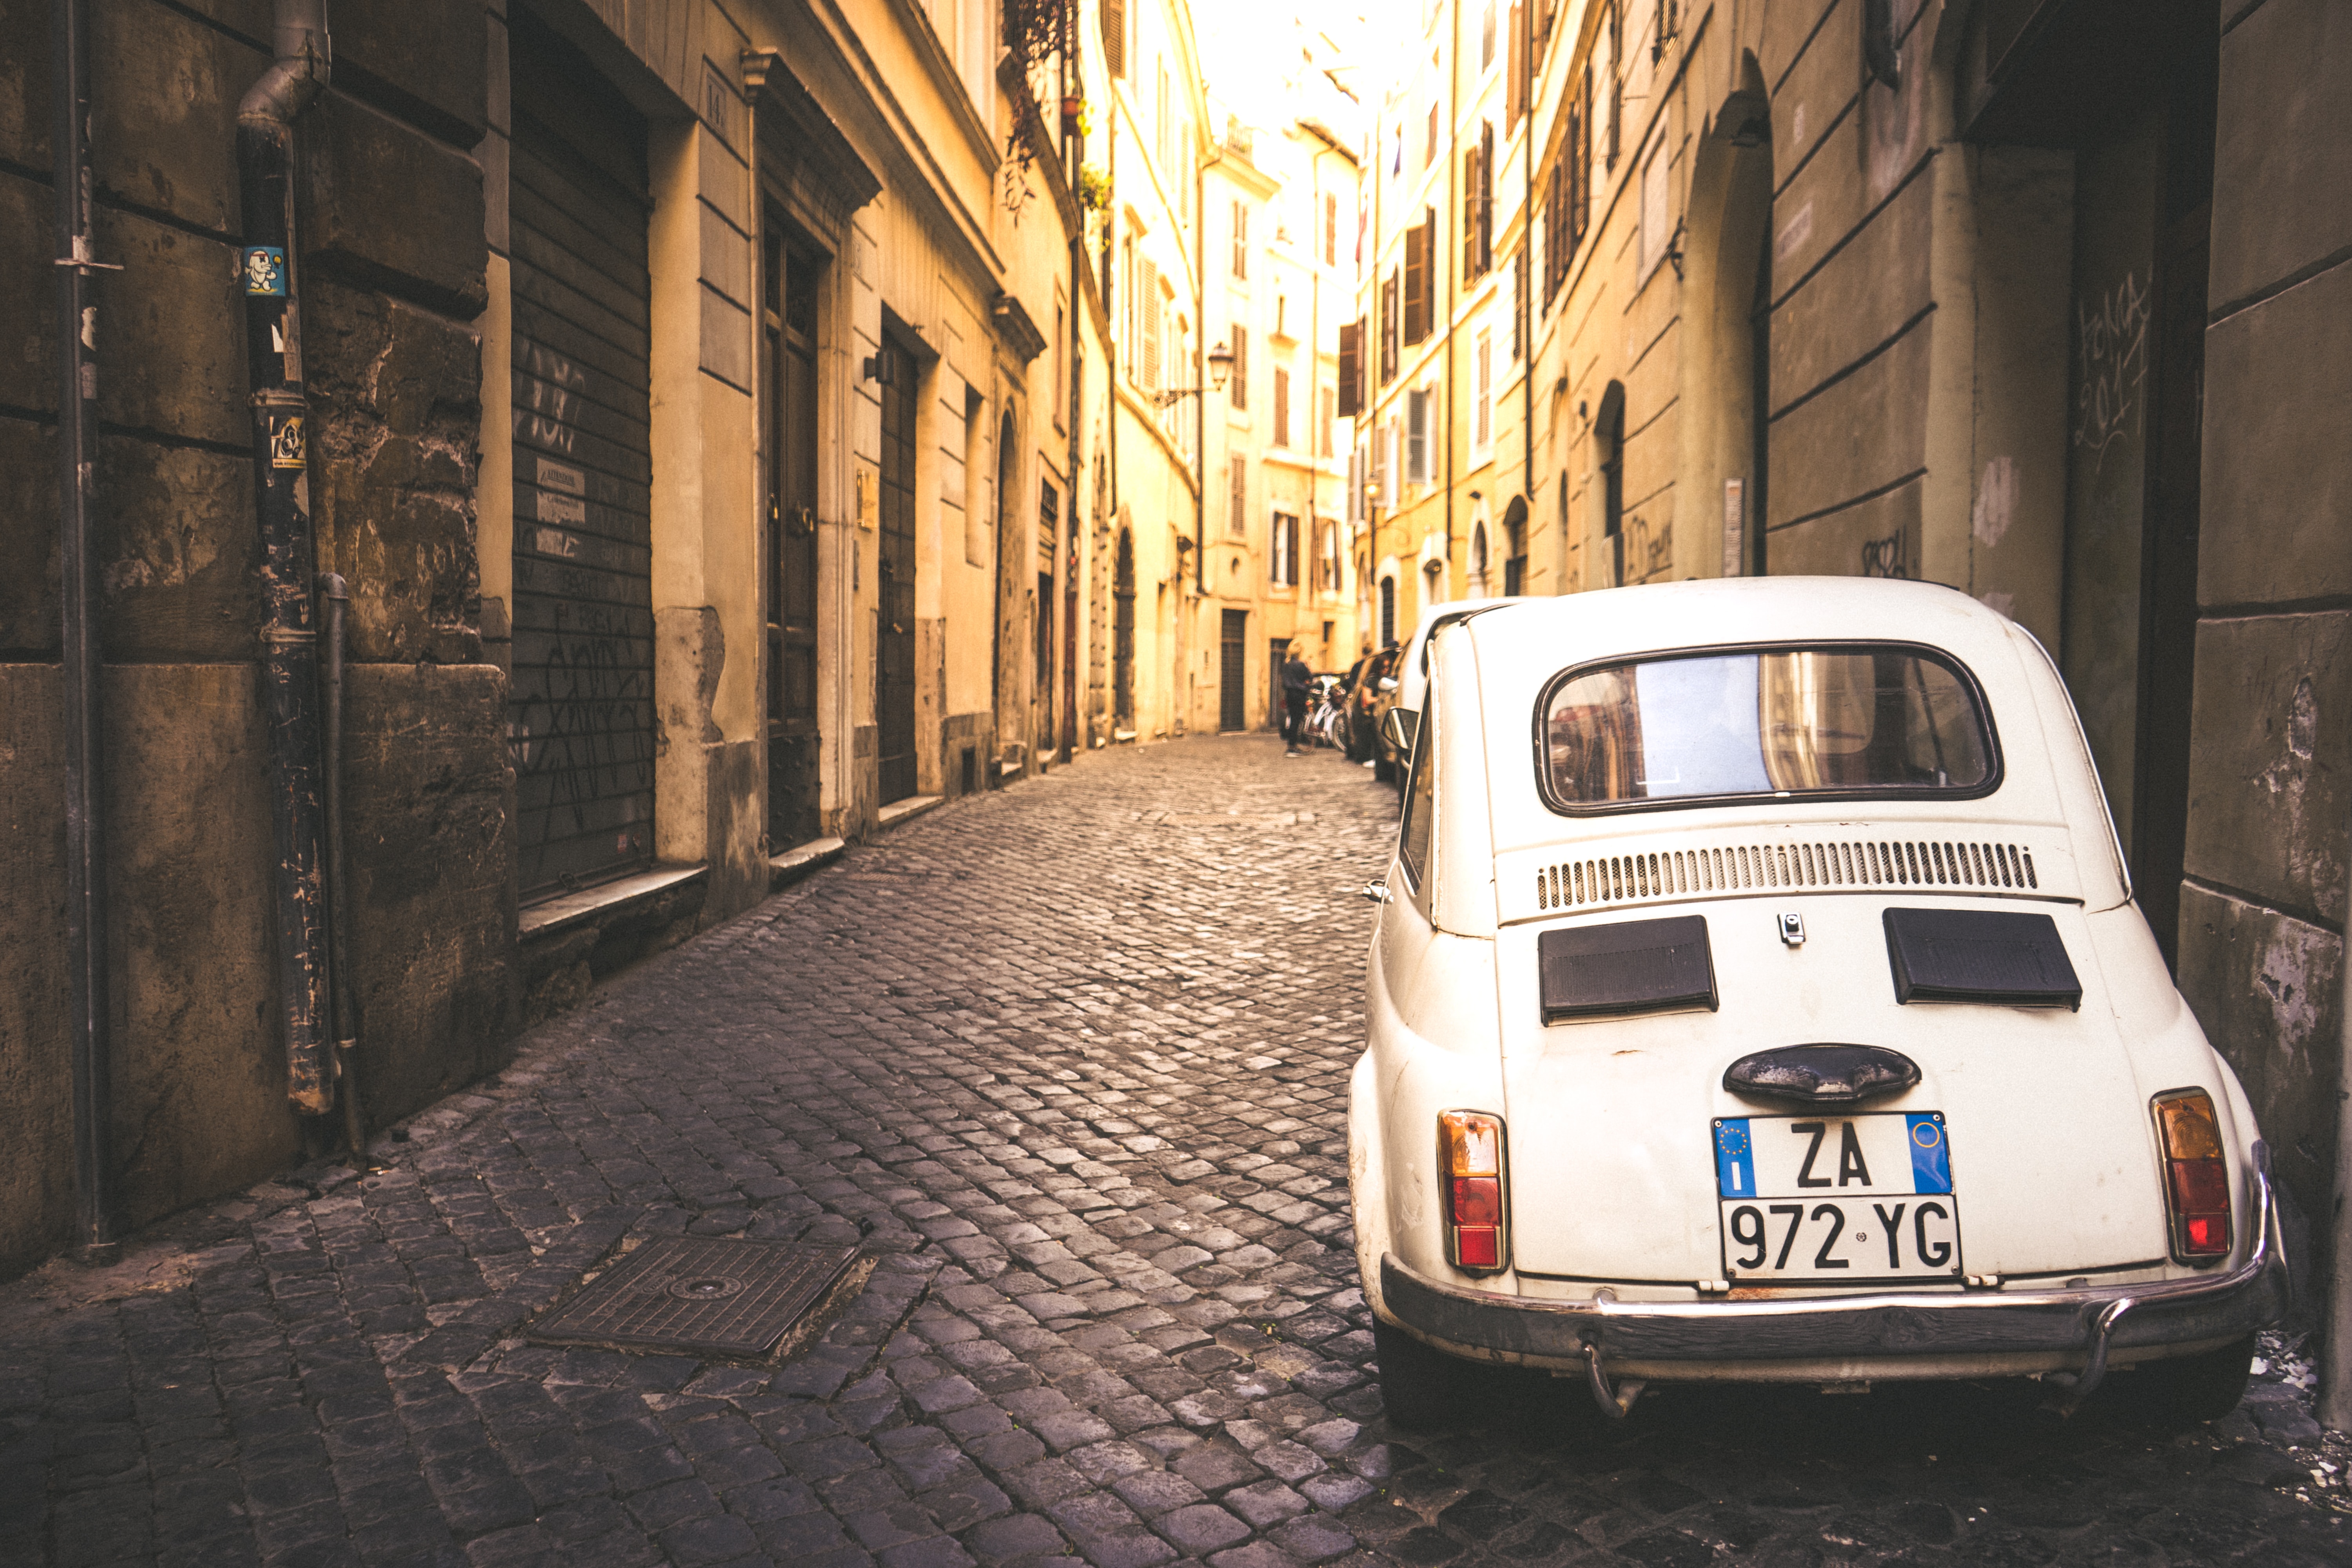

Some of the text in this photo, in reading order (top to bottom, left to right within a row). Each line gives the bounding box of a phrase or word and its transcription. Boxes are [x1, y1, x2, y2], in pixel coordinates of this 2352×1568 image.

[1731, 1161, 1742, 1191] I
[1791, 1122, 1872, 1188] ZA
[1731, 1201, 1951, 1270] 972 YG
